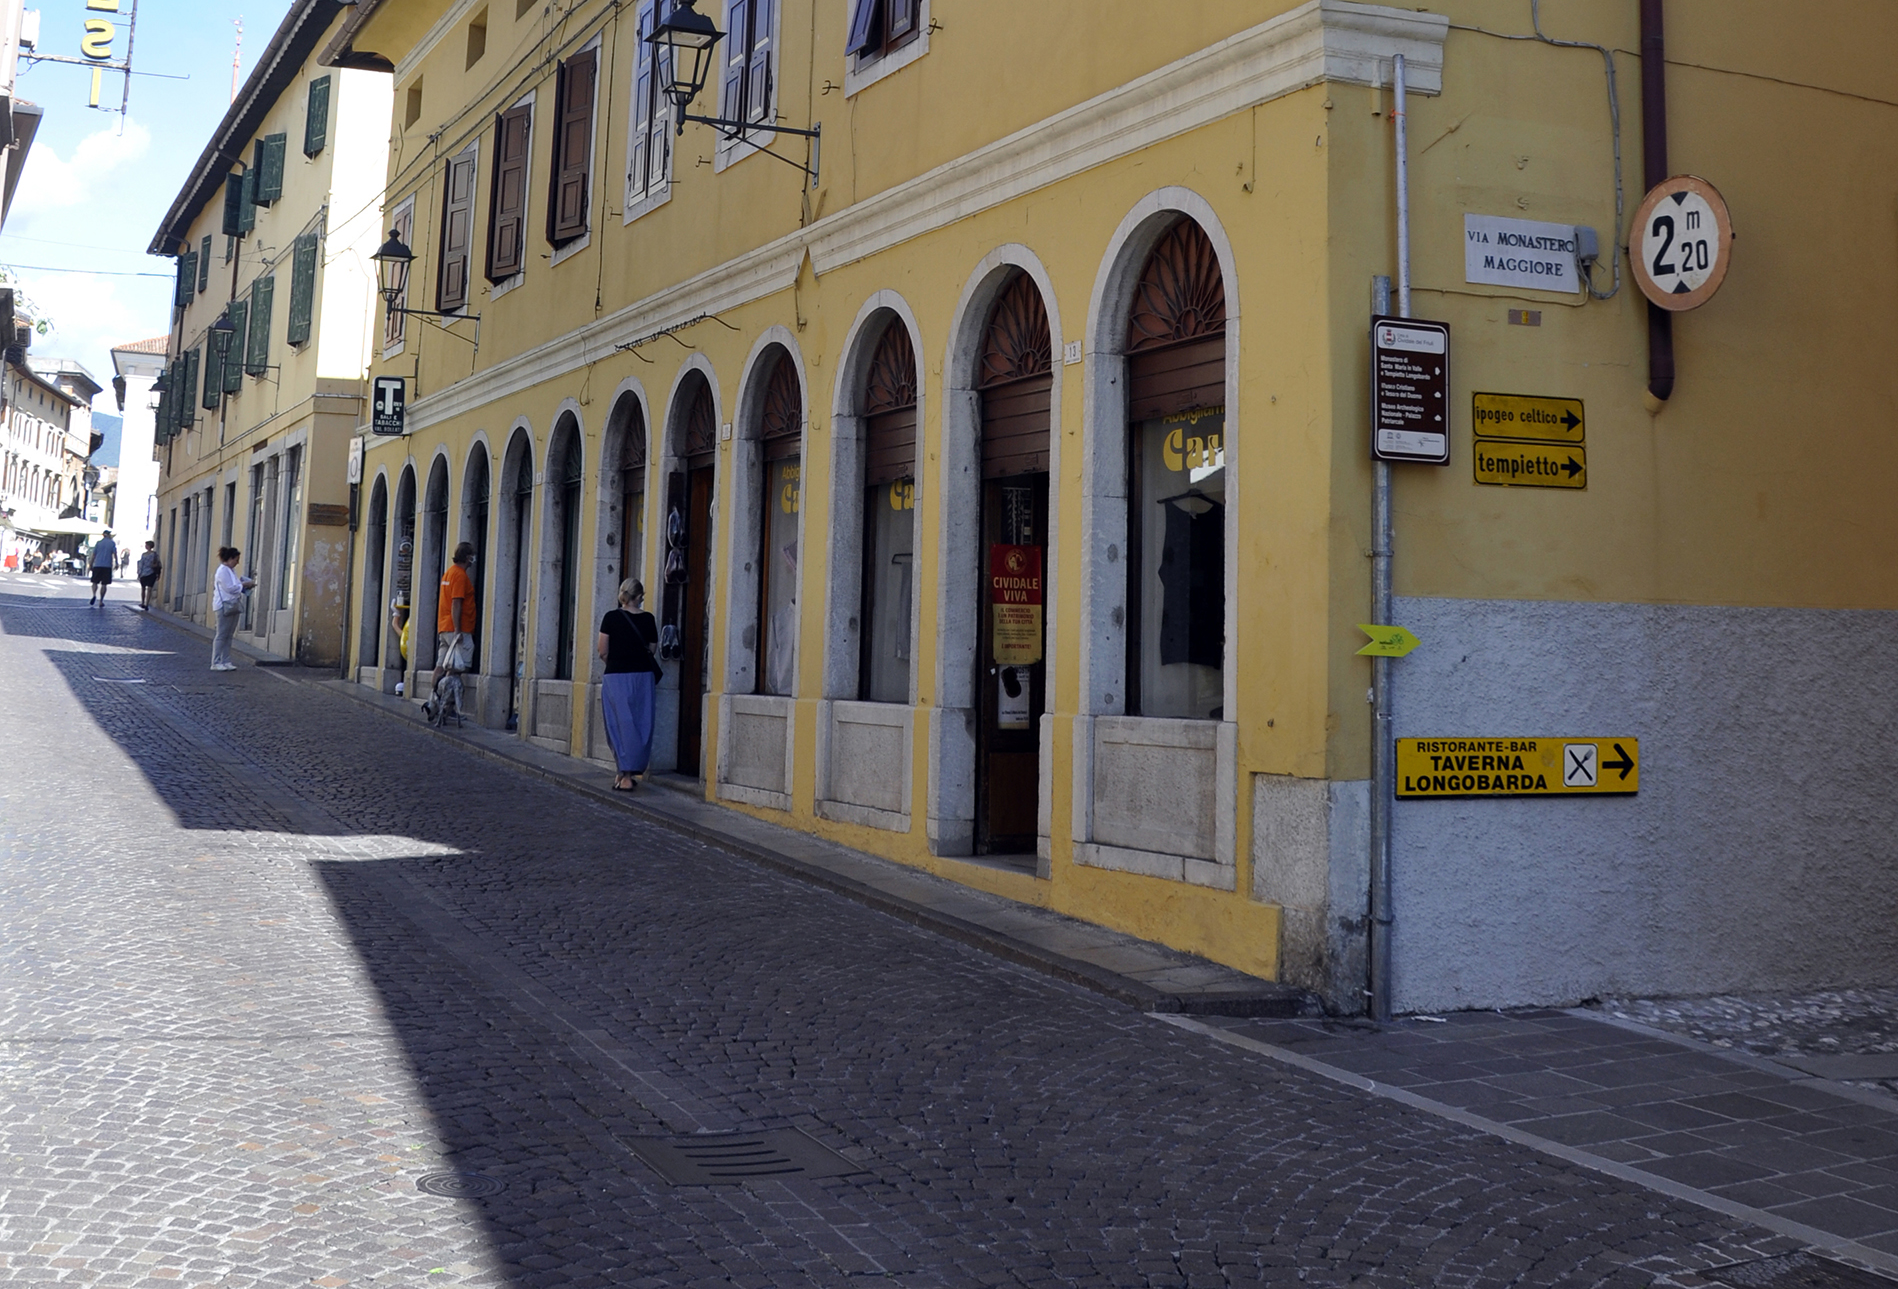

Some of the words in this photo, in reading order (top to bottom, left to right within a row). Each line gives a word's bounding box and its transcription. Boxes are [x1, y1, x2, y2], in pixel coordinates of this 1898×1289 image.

[1686, 210, 1700, 230] m
[1467, 230, 1489, 244] VIA
[1497, 232, 1575, 253] MONASTERO
[1483, 255, 1563, 277] MAGGIORE
[378, 380, 401, 415] T
[1475, 405, 1514, 424] ipogeo
[1520, 408, 1558, 424] celtico
[1478, 452, 1559, 479] tempietto
[993, 576, 1039, 590] CIVIDALE
[1003, 590, 1028, 602] VIVA
[1416, 741, 1538, 753] RISTORANTE-BAR
[1430, 755, 1525, 772] TAVERNA
[1405, 774, 1548, 792] LONGOBARDA
